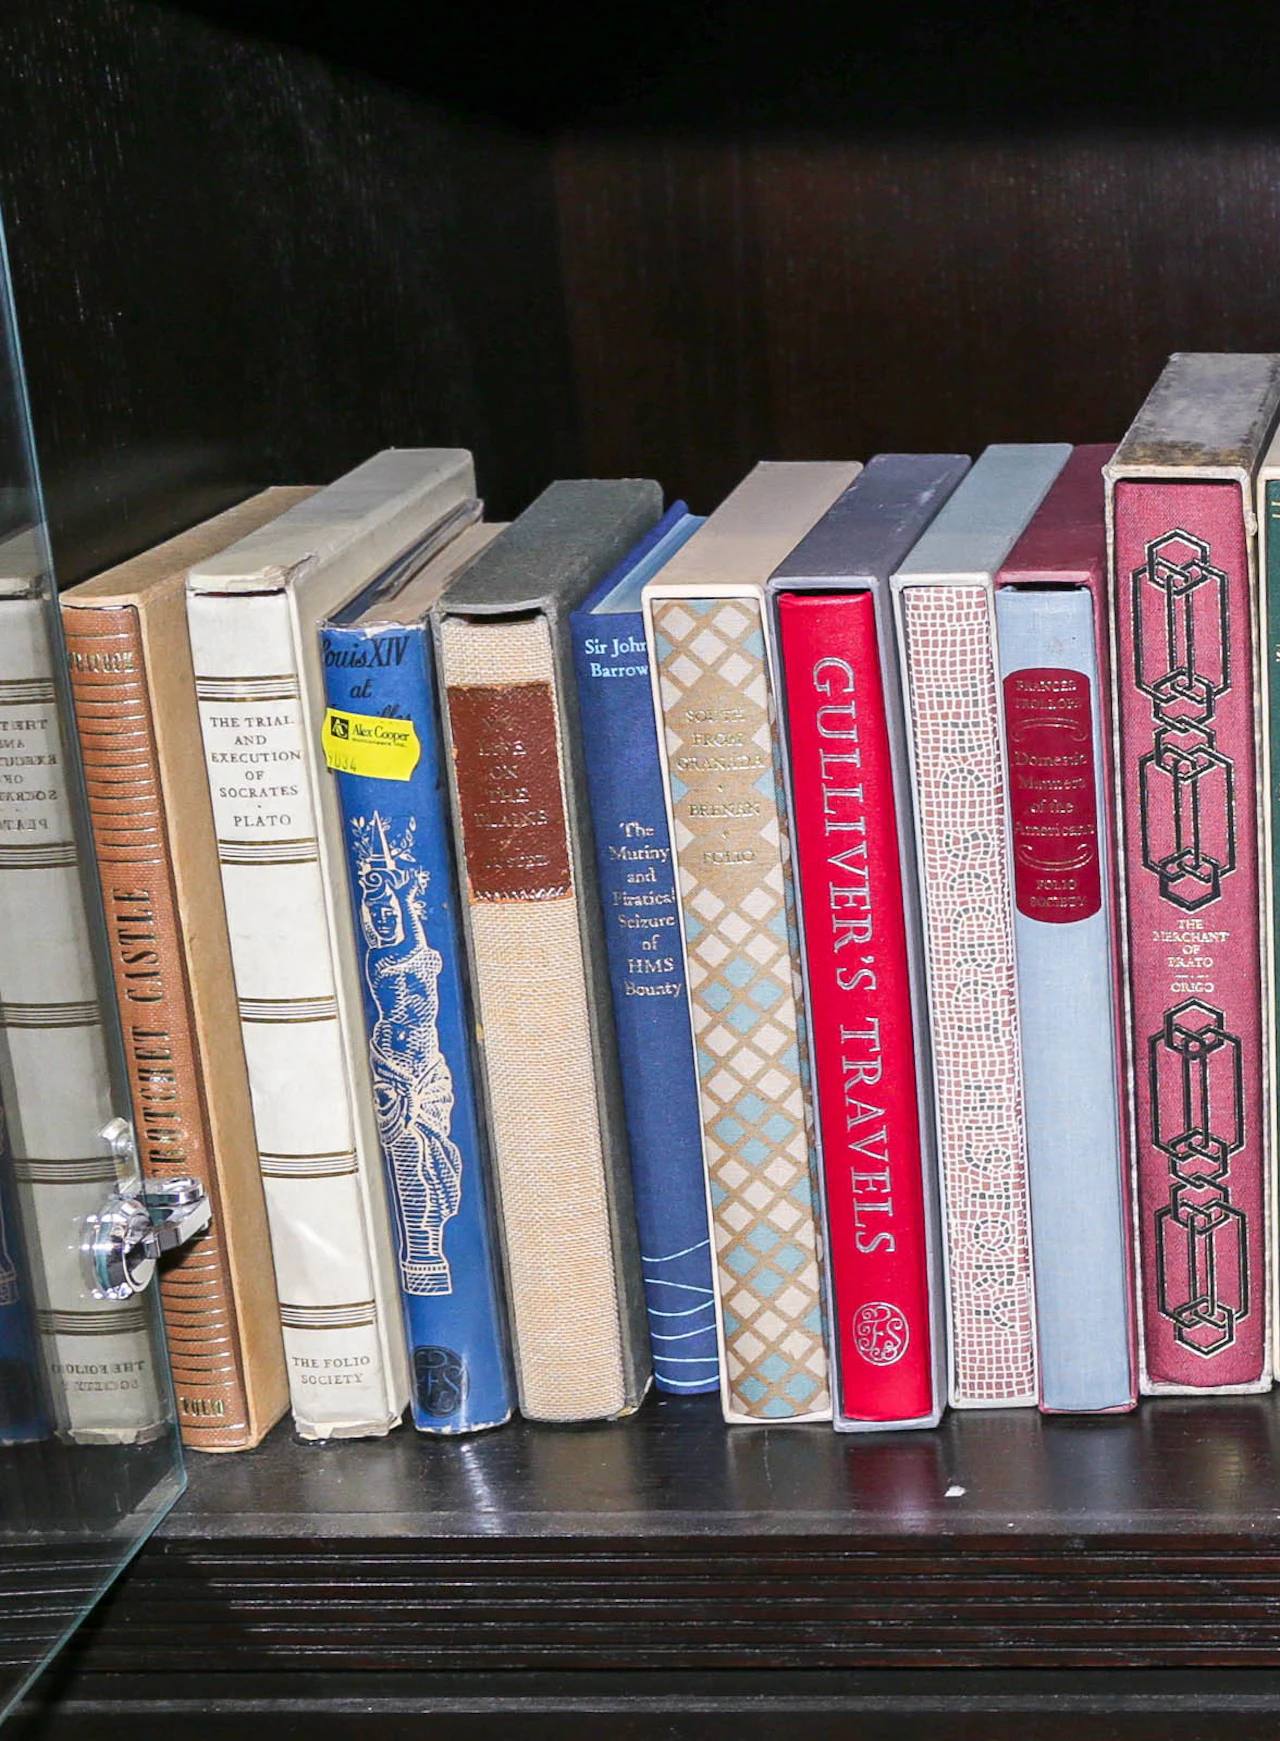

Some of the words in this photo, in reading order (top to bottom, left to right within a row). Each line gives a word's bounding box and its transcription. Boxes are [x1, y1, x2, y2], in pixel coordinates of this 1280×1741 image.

[584, 638, 608, 655] Sir
[590, 662, 649, 678] Barrow
[350, 679, 372, 699] at
[210, 717, 239, 728] THE
[244, 715, 294, 728] TRIAL
[234, 735, 267, 746] AND
[352, 723, 373, 738] Alex
[374, 724, 409, 743] Cooper
[691, 732, 744, 748] FROM
[211, 752, 302, 764] EXECUTION
[677, 755, 767, 772] GRANADA
[245, 770, 264, 781] OF
[219, 786, 298, 798] SOCRATES
[688, 803, 761, 819] BRENAN
[234, 815, 291, 828] PLATO
[619, 822, 654, 838] The
[609, 845, 670, 863] Mutiny
[627, 867, 657, 884] and
[612, 887, 676, 907] Piratical
[618, 914, 676, 929] Seizure
[1177, 918, 1204, 930] THE
[641, 934, 660, 951] of
[1152, 931, 1230, 943] MERCHANT
[112, 888, 164, 1004] CASTLE
[1182, 944, 1202, 955] OF
[628, 957, 675, 974] HMS
[624, 979, 682, 998] Bounty
[838, 1016, 896, 1255] TRAVELS
[292, 1356, 319, 1369] THE
[324, 1356, 370, 1369] FOLIO
[300, 1373, 363, 1386] SOCIETY
